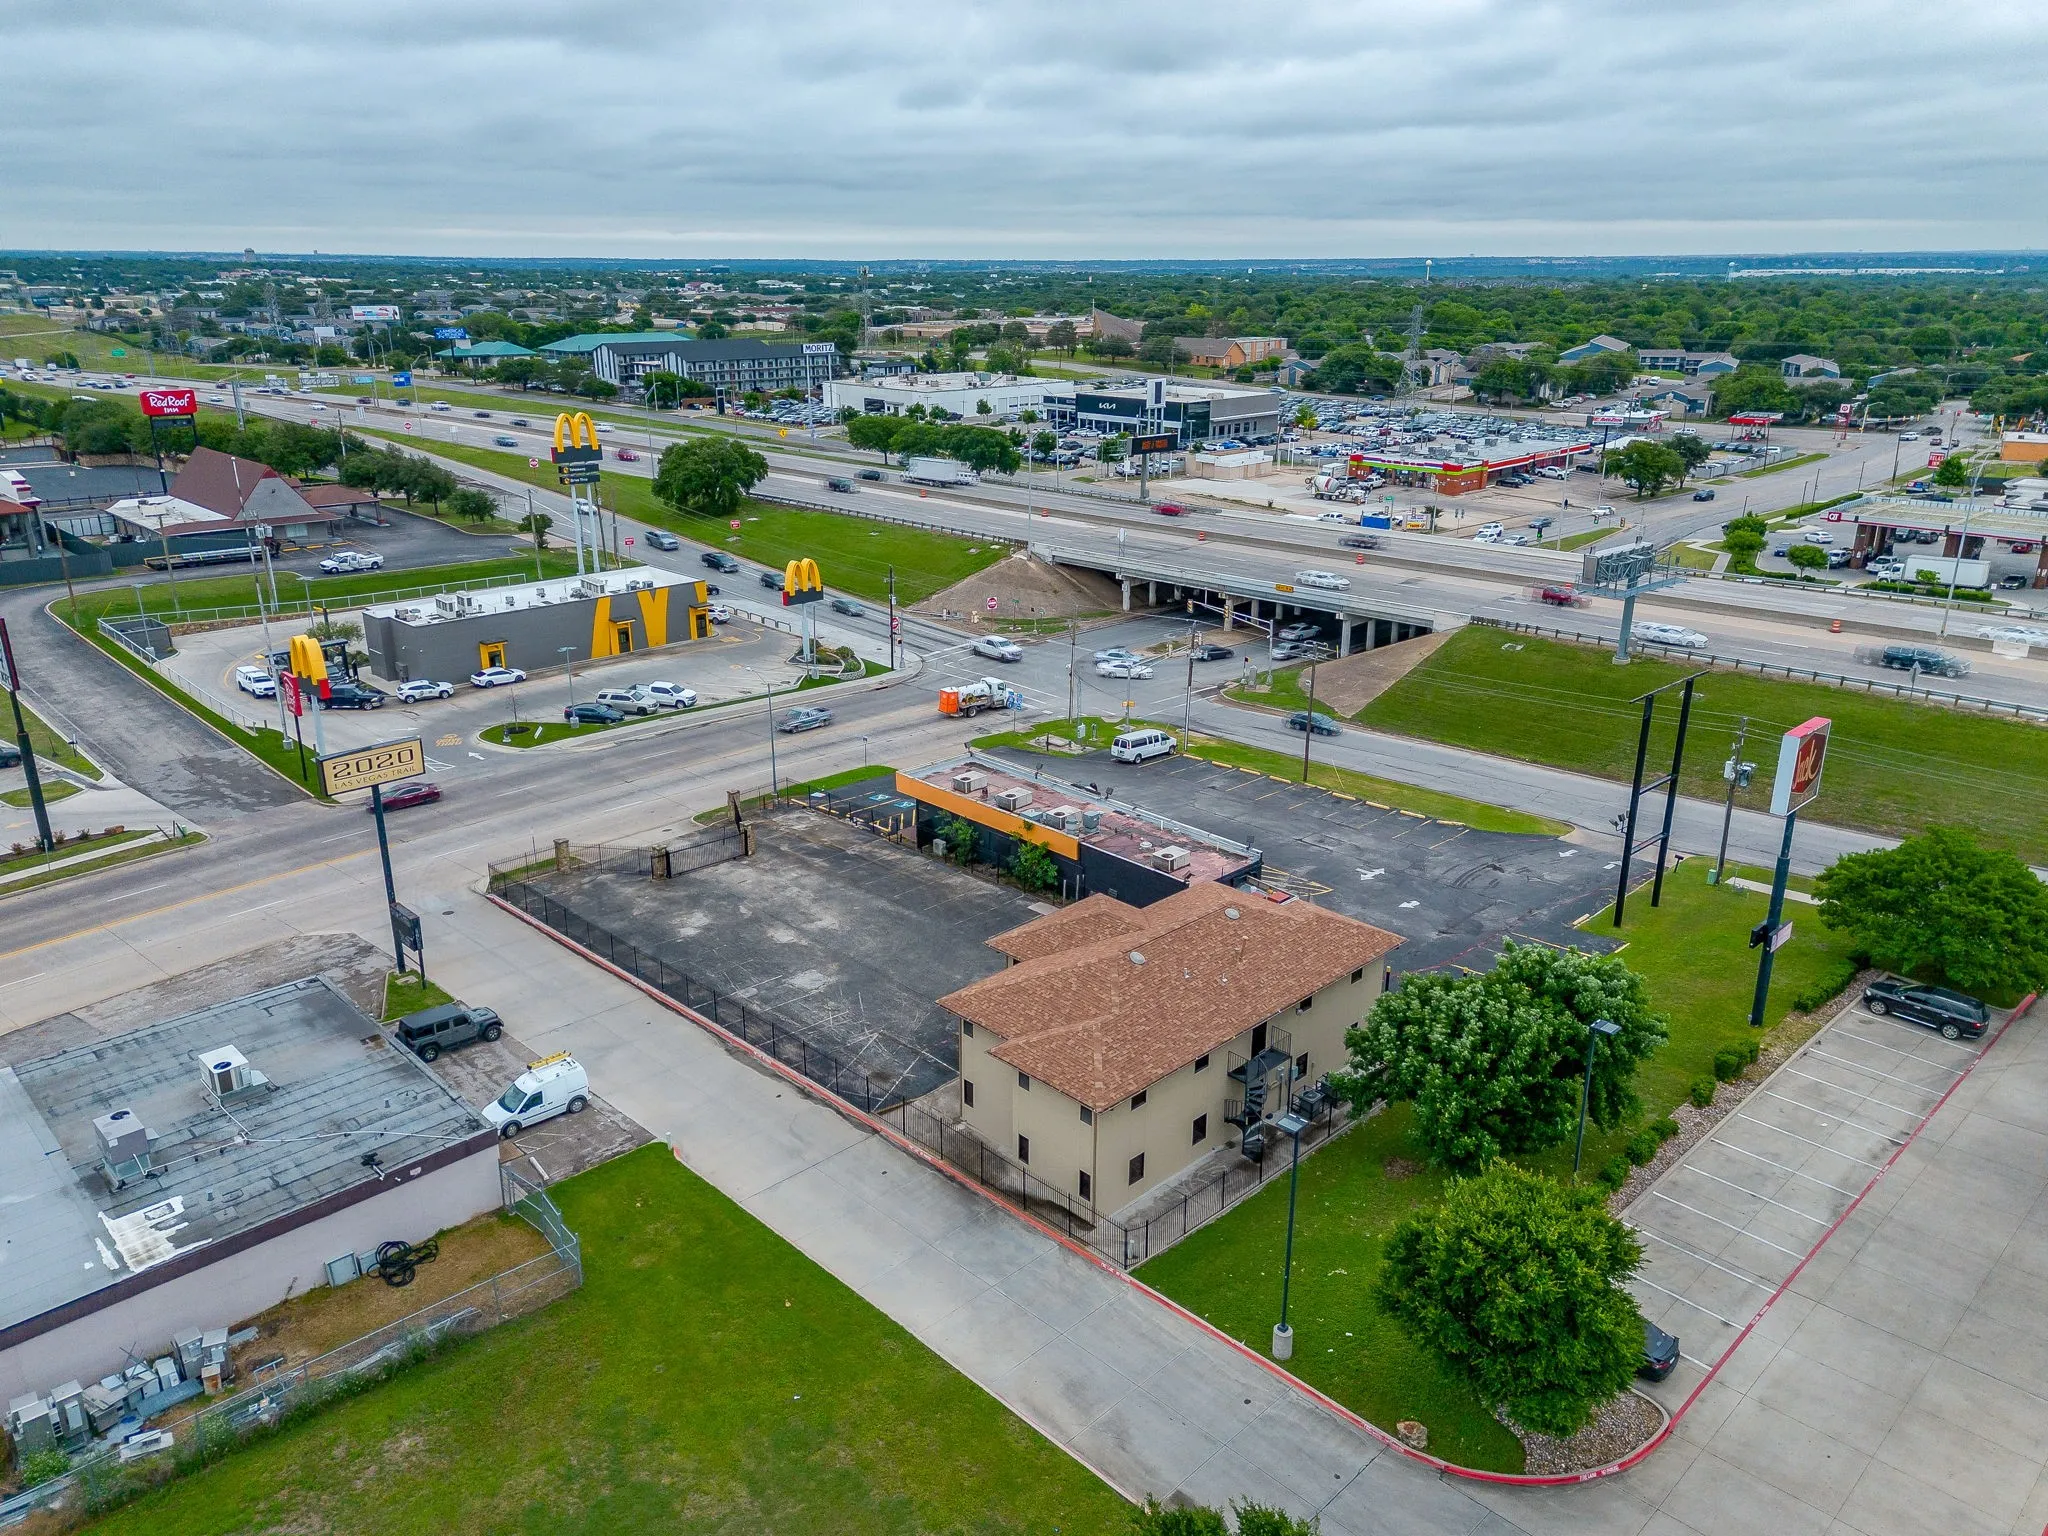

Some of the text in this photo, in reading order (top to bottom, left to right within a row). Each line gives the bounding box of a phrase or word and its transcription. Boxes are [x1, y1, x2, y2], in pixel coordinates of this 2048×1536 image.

[804, 343, 834, 352] MORITZ
[149, 393, 190, 407] Red Roof
[332, 748, 414, 779] 2020
[1792, 739, 1822, 790] Jack
[334, 766, 416, 790] LAS VEGAS TRAIL
